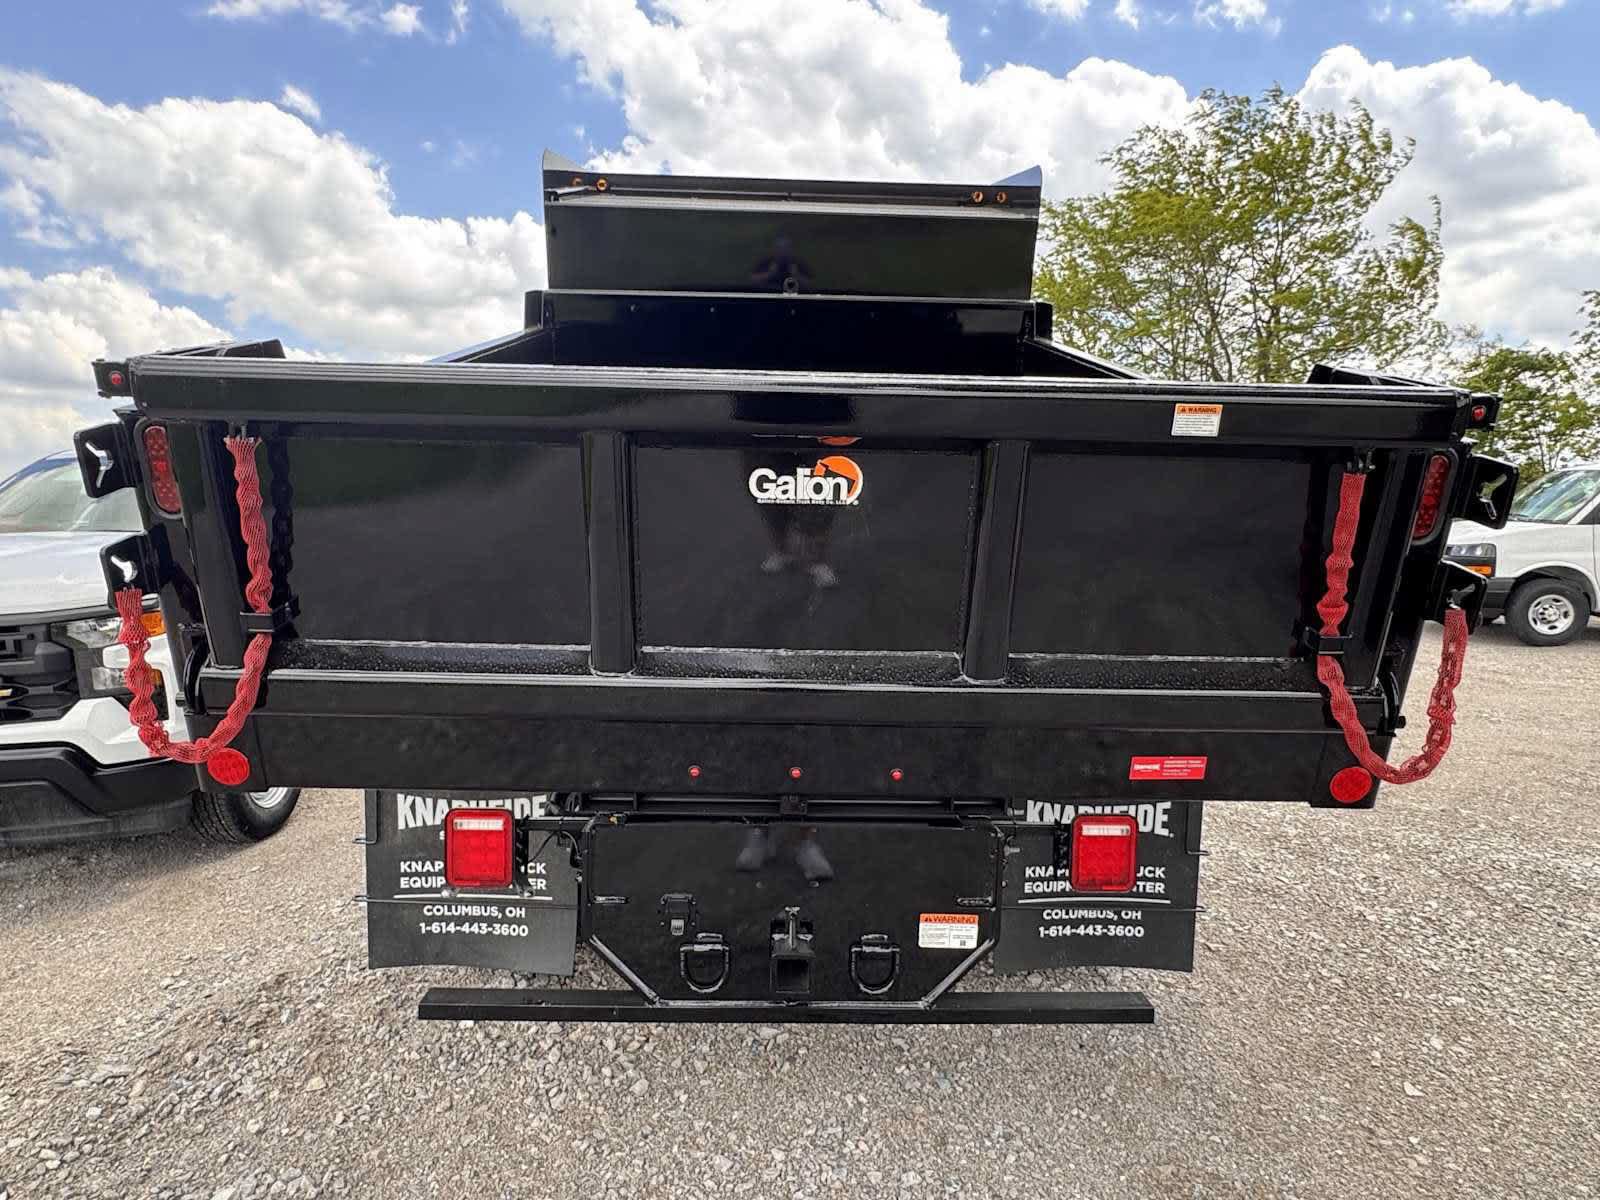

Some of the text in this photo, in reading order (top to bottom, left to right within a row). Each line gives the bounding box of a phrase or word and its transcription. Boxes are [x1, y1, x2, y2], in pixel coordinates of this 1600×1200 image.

[748, 467, 848, 501] Galion
[400, 876, 447, 888] EQUIP
[423, 904, 526, 919] COLUMBUS, OH
[1042, 909, 1142, 921] COLUMBUS, OH
[933, 916, 976, 924] WARNING
[419, 922, 529, 937] 1-614-443-3600
[1038, 924, 1145, 938] 1-614-443-3600
